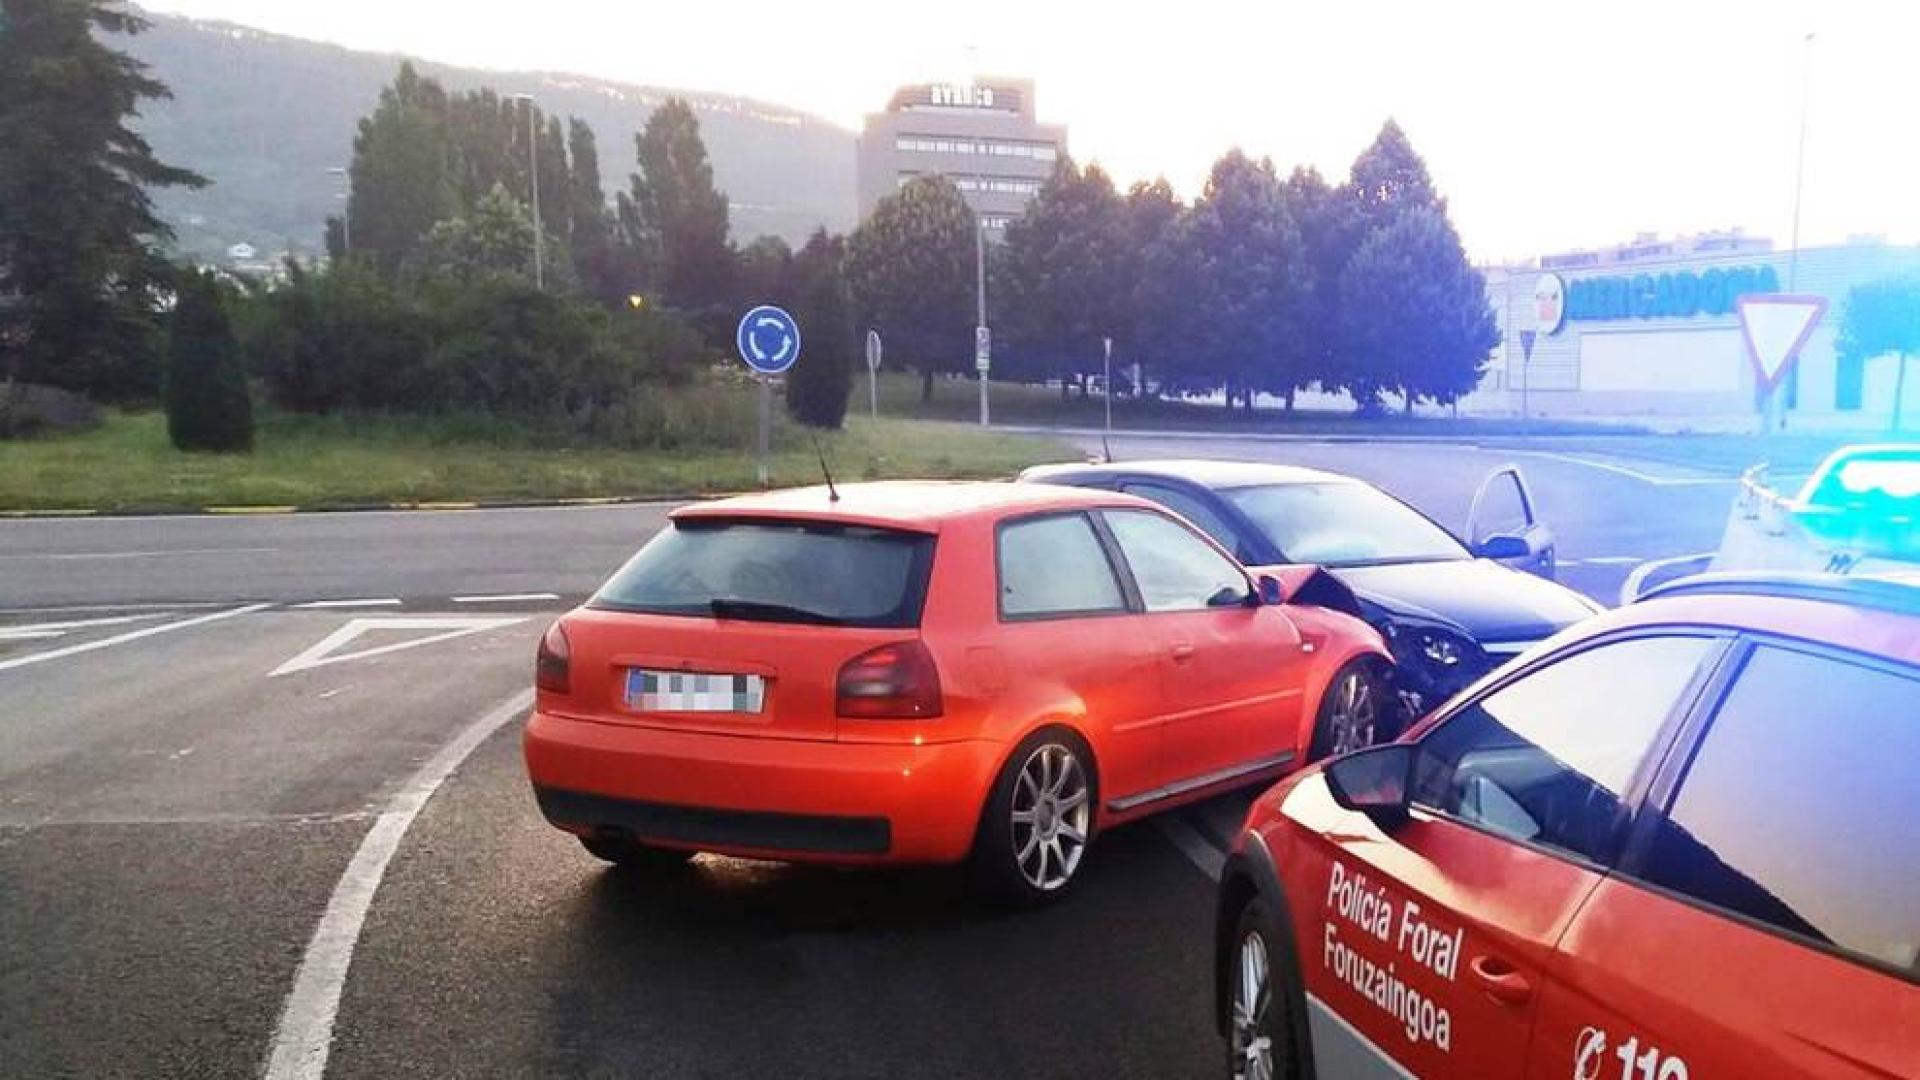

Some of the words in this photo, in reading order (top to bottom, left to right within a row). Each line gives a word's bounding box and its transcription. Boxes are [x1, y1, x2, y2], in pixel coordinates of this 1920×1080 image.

[1327, 862, 1391, 941] Policía
[1398, 901, 1463, 981] Foral
[1324, 923, 1450, 1052] Foruzaingoa
